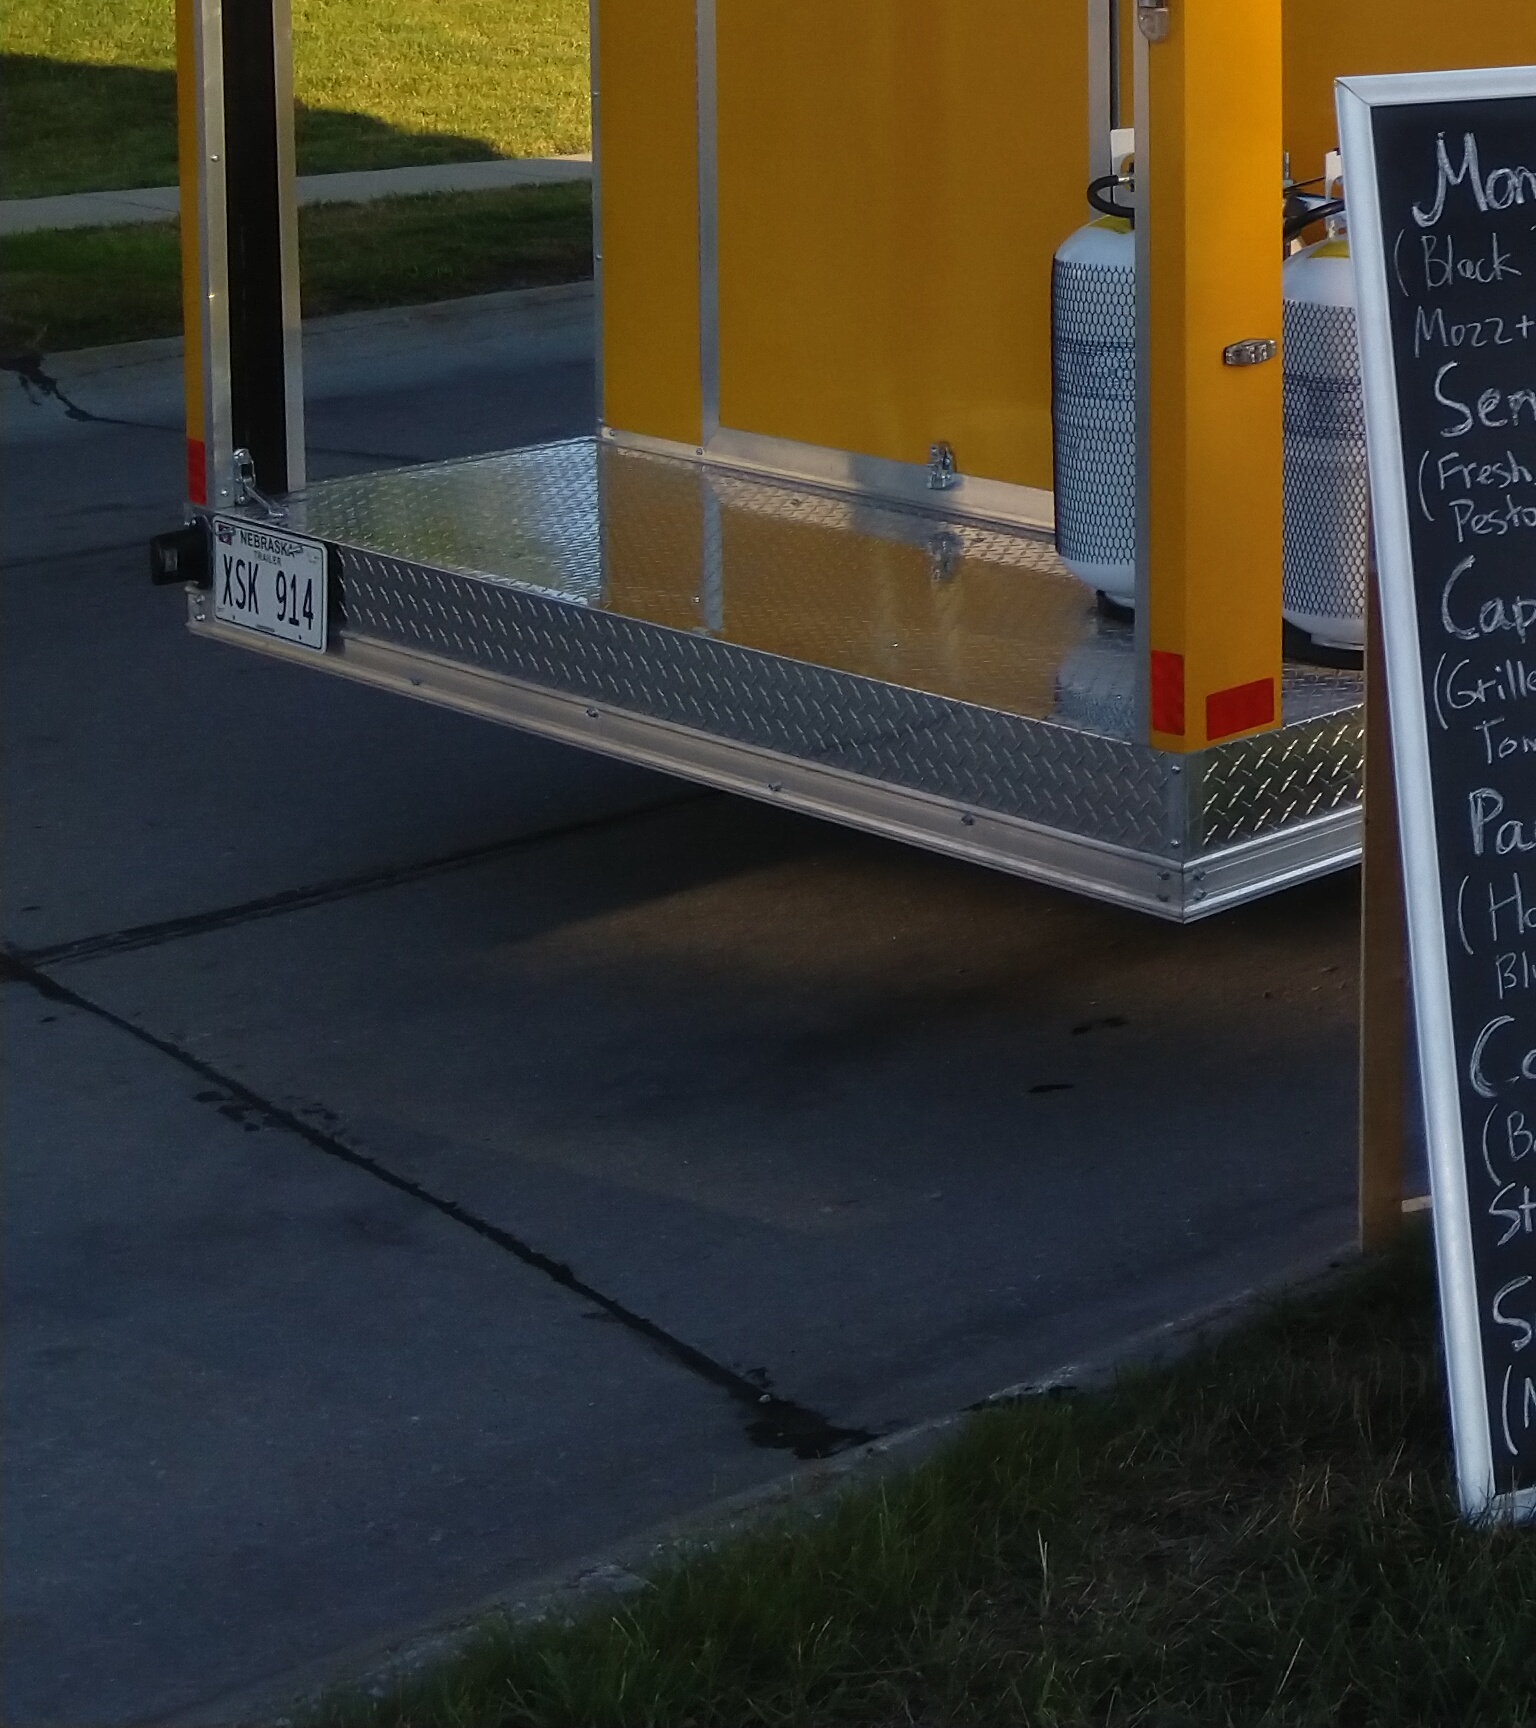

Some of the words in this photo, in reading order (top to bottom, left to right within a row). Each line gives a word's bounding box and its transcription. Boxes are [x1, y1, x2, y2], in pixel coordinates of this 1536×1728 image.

[240, 530, 297, 558] NEBRASKA
[223, 554, 259, 614] XSK
[276, 571, 314, 630] 914
